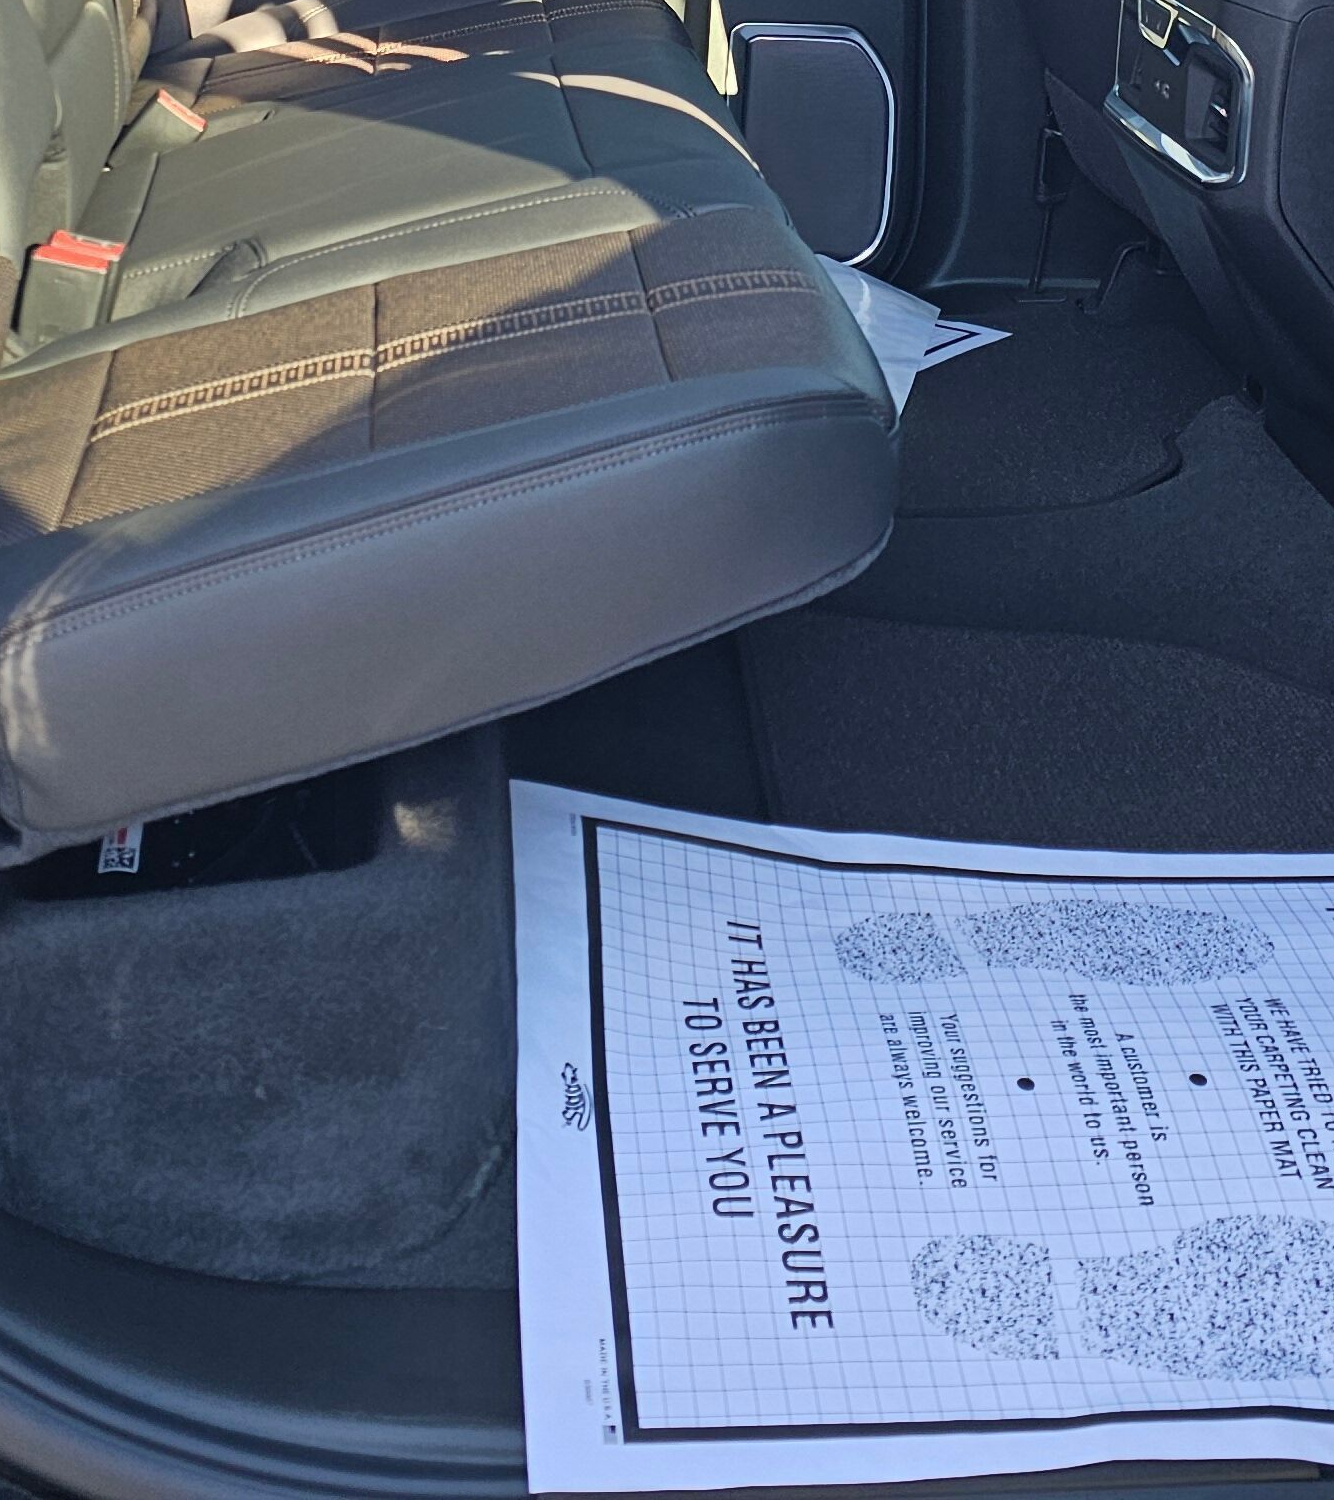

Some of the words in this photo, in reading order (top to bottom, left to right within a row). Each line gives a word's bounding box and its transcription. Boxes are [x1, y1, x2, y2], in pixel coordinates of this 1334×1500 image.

[726, 920, 763, 951] IT
[730, 959, 775, 1011] HAS
[1068, 994, 1089, 1013] the
[1264, 998, 1290, 1017] WE
[682, 997, 723, 1031] TO
[879, 1013, 898, 1034] are
[1050, 1019, 1069, 1032] in
[1078, 1017, 1108, 1049] most
[1276, 1020, 1310, 1054] HAVE
[742, 1018, 792, 1090] BEEN
[908, 1011, 942, 1079] improving
[1057, 1036, 1078, 1057] the
[1115, 1033, 1134, 1042] A
[1235, 997, 1269, 1031] YOUR
[1255, 1034, 1311, 1121] CARPETING
[887, 1039, 914, 1089] always
[1067, 1061, 1099, 1106] world
[1120, 1046, 1160, 1119] customer
[1297, 1057, 1333, 1104] TRIED
[688, 1041, 742, 1138] SERVE
[756, 1101, 797, 1122] A
[930, 1085, 950, 1112] our
[939, 1013, 961, 1043] Your
[950, 1048, 989, 1147] suggestions
[977, 1154, 999, 1182] for
[1095, 1054, 1137, 1132] important
[1210, 1003, 1243, 1037] WITH
[1229, 1040, 1260, 1072] THIS
[1245, 1077, 1285, 1133] PAPER
[1269, 1140, 1302, 1180] MAT
[902, 1095, 933, 1186] welcome.
[1083, 1112, 1102, 1129] to
[1150, 1126, 1169, 1142] is
[938, 1119, 968, 1188] service
[1090, 1137, 1109, 1165] us.
[1117, 1139, 1155, 1207] person
[705, 1146, 755, 1219] YOU
[763, 1130, 835, 1331] PLEASURE
